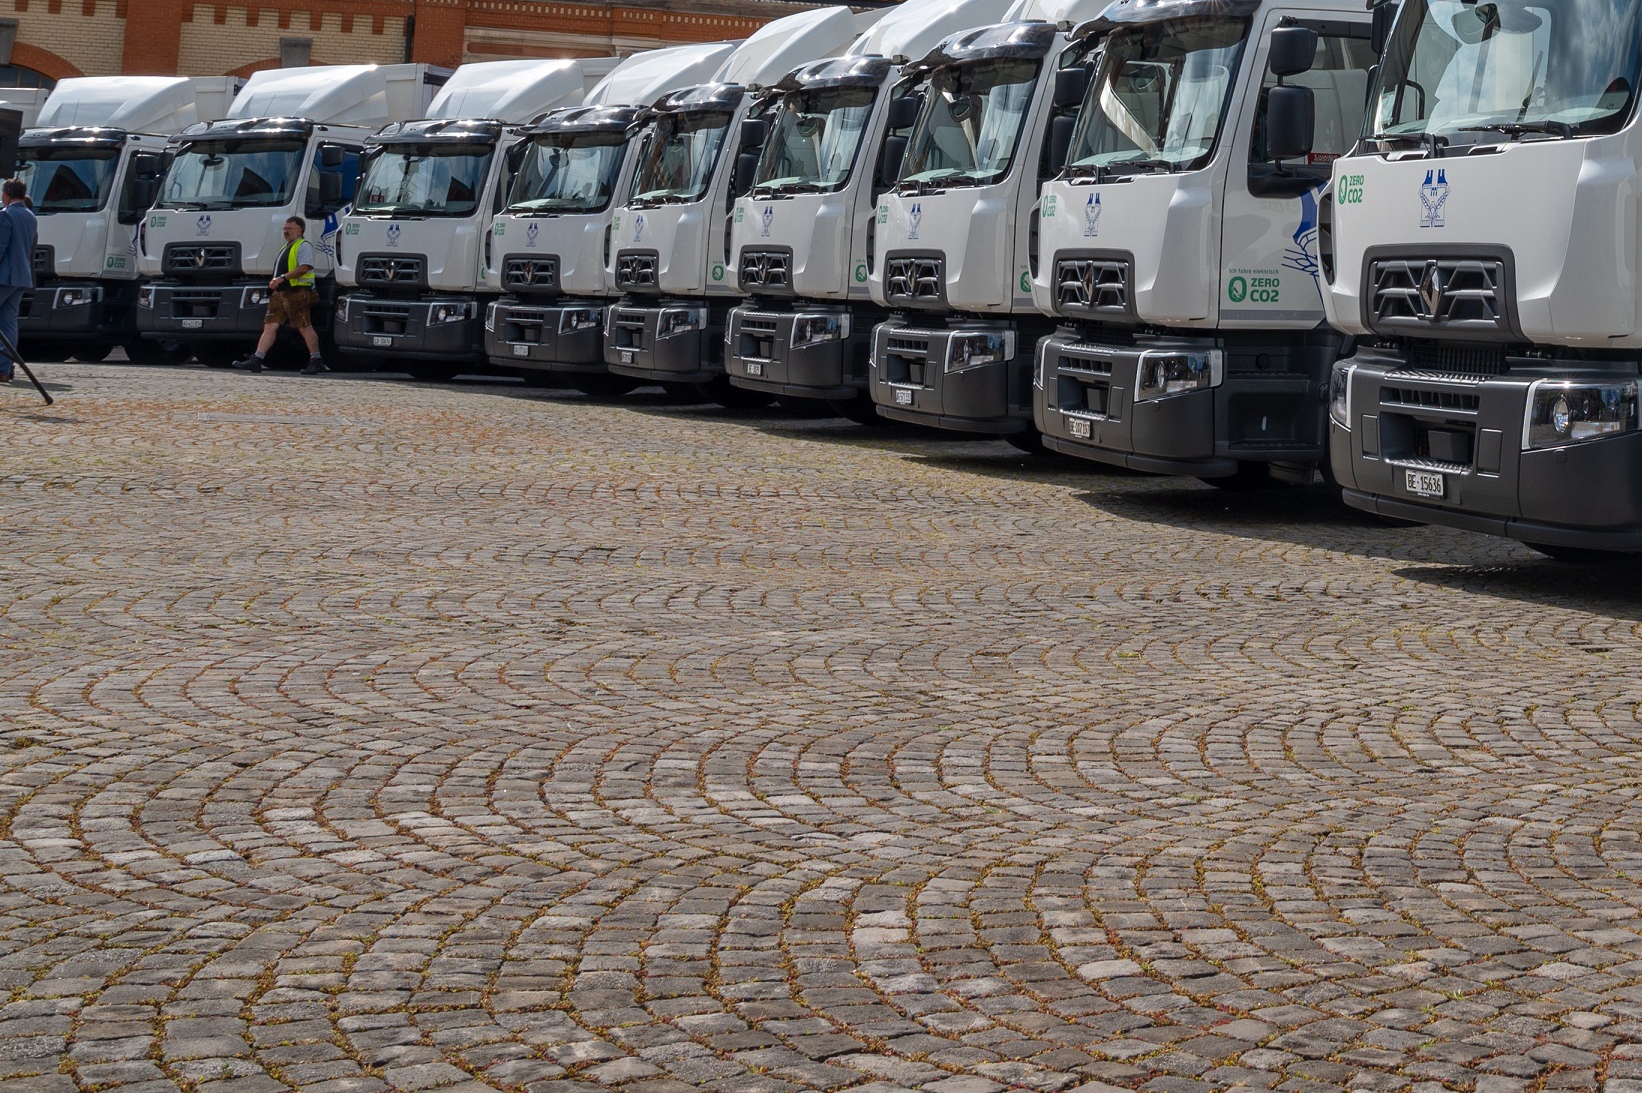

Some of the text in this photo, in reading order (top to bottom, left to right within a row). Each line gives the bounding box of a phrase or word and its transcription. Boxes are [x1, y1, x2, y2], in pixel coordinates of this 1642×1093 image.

[1349, 174, 1364, 186] ZERO
[1348, 188, 1363, 204] CO2
[1250, 277, 1280, 288] ZERO
[1249, 289, 1280, 303] CO2
